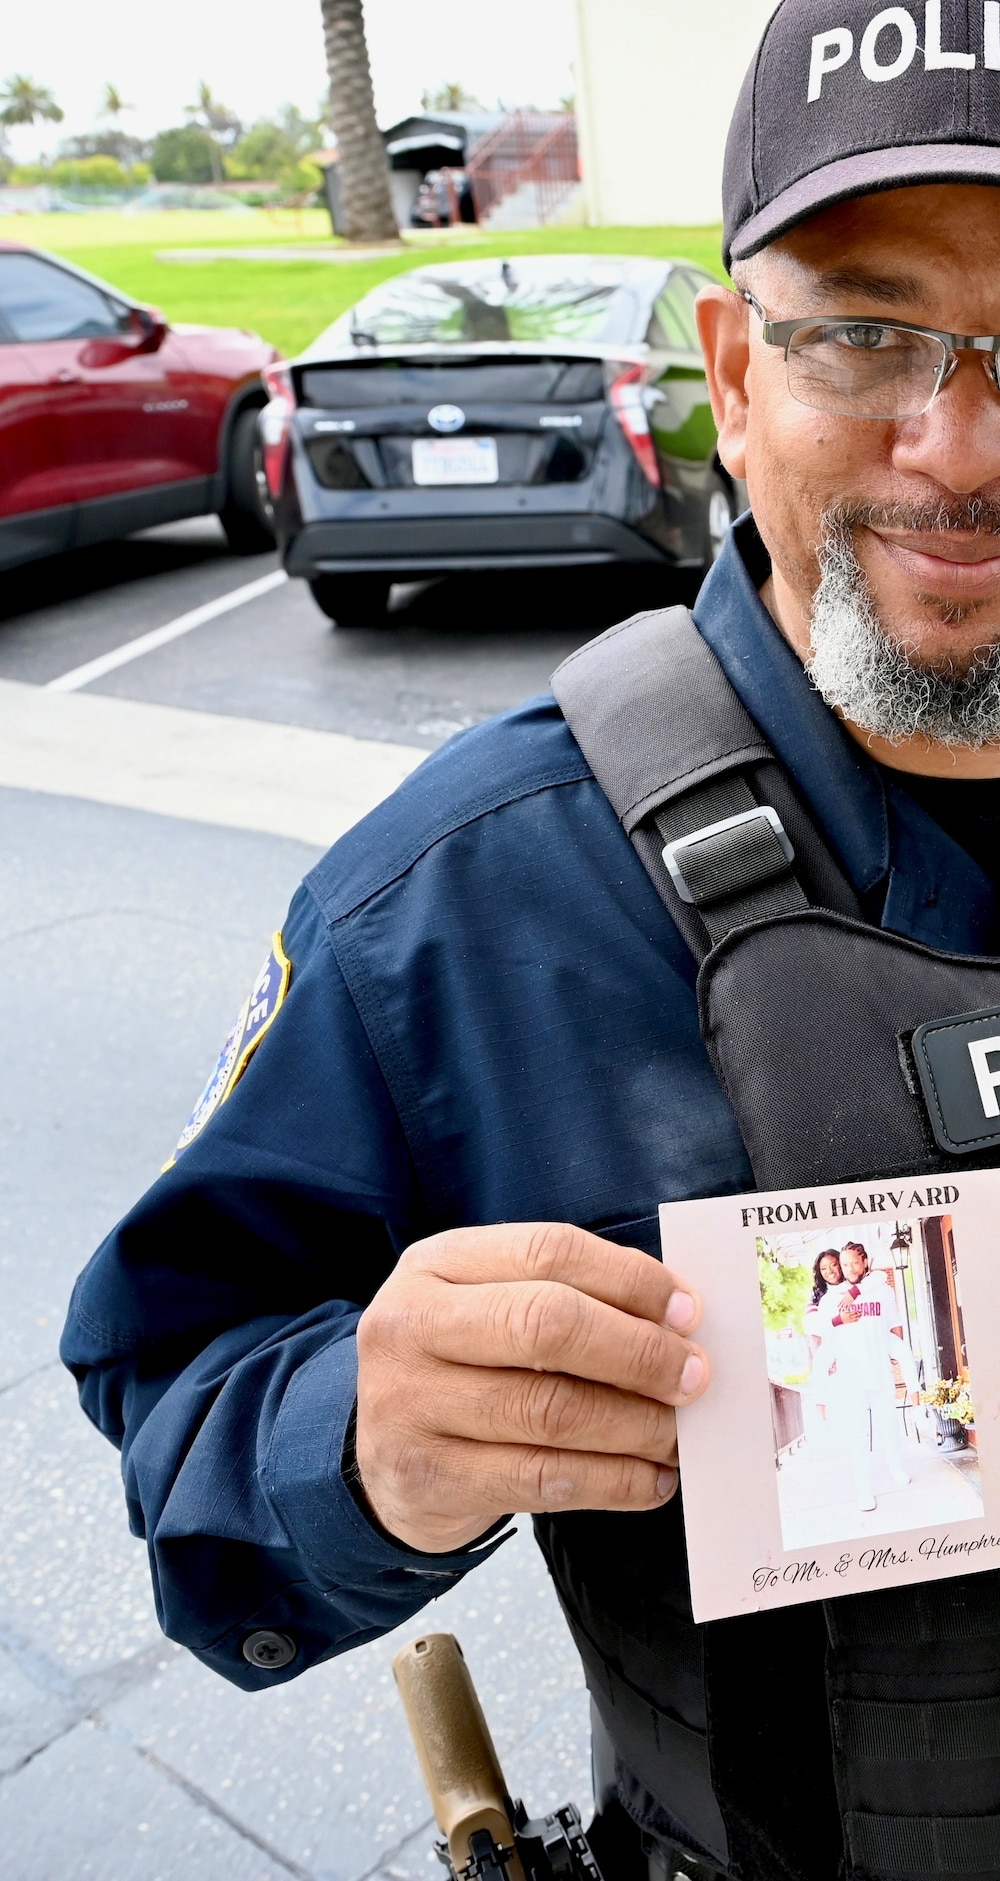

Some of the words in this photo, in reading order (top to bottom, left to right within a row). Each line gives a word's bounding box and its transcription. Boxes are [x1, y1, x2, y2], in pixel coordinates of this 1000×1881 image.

[741, 1201, 818, 1227] FROM
[830, 1185, 960, 1217] HARVARD
[753, 1566, 781, 1592] To
[783, 1561, 828, 1583] Mr.
[834, 1553, 853, 1577] &
[859, 1547, 913, 1570] Mrs.
